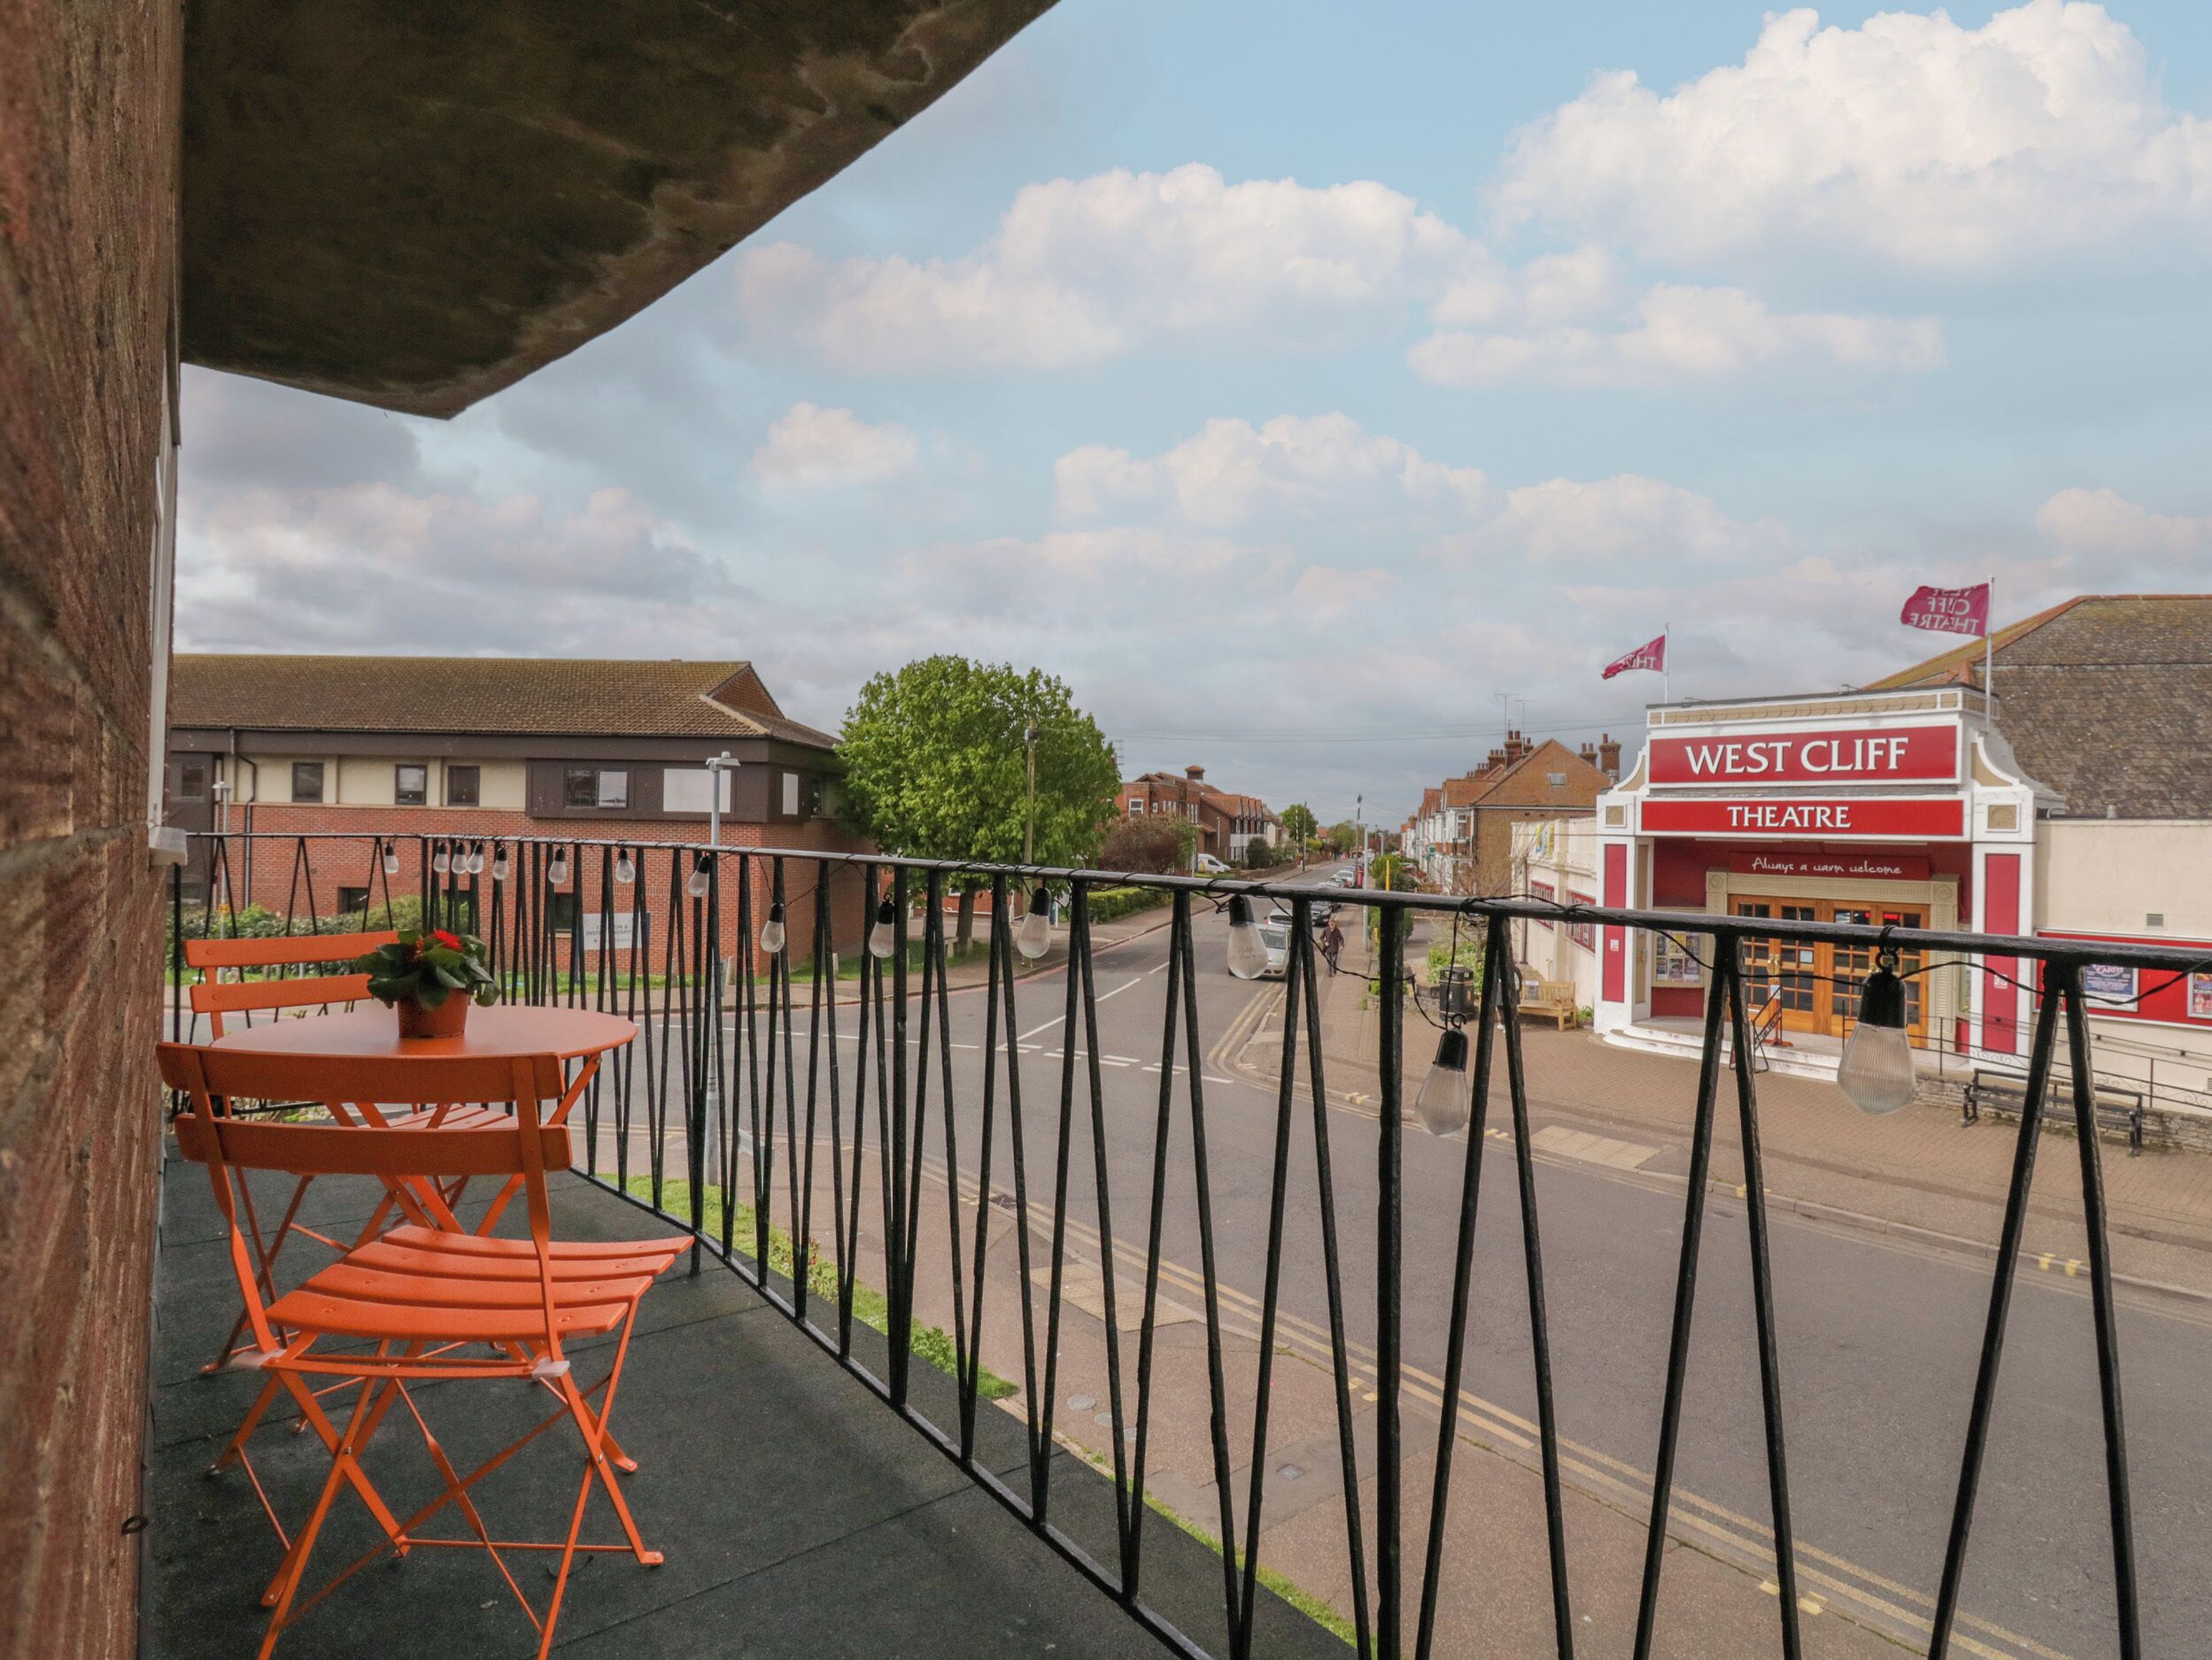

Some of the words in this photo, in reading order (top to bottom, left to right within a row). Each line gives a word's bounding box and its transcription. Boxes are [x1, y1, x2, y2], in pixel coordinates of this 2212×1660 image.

[1684, 741, 1792, 776] WEST
[1800, 737, 1909, 773] CLIFF
[1727, 806, 1852, 829] THEATRE
[1752, 857, 1795, 874] Always
[1813, 864, 1845, 873] warm
[1849, 861, 1902, 875] welcome
